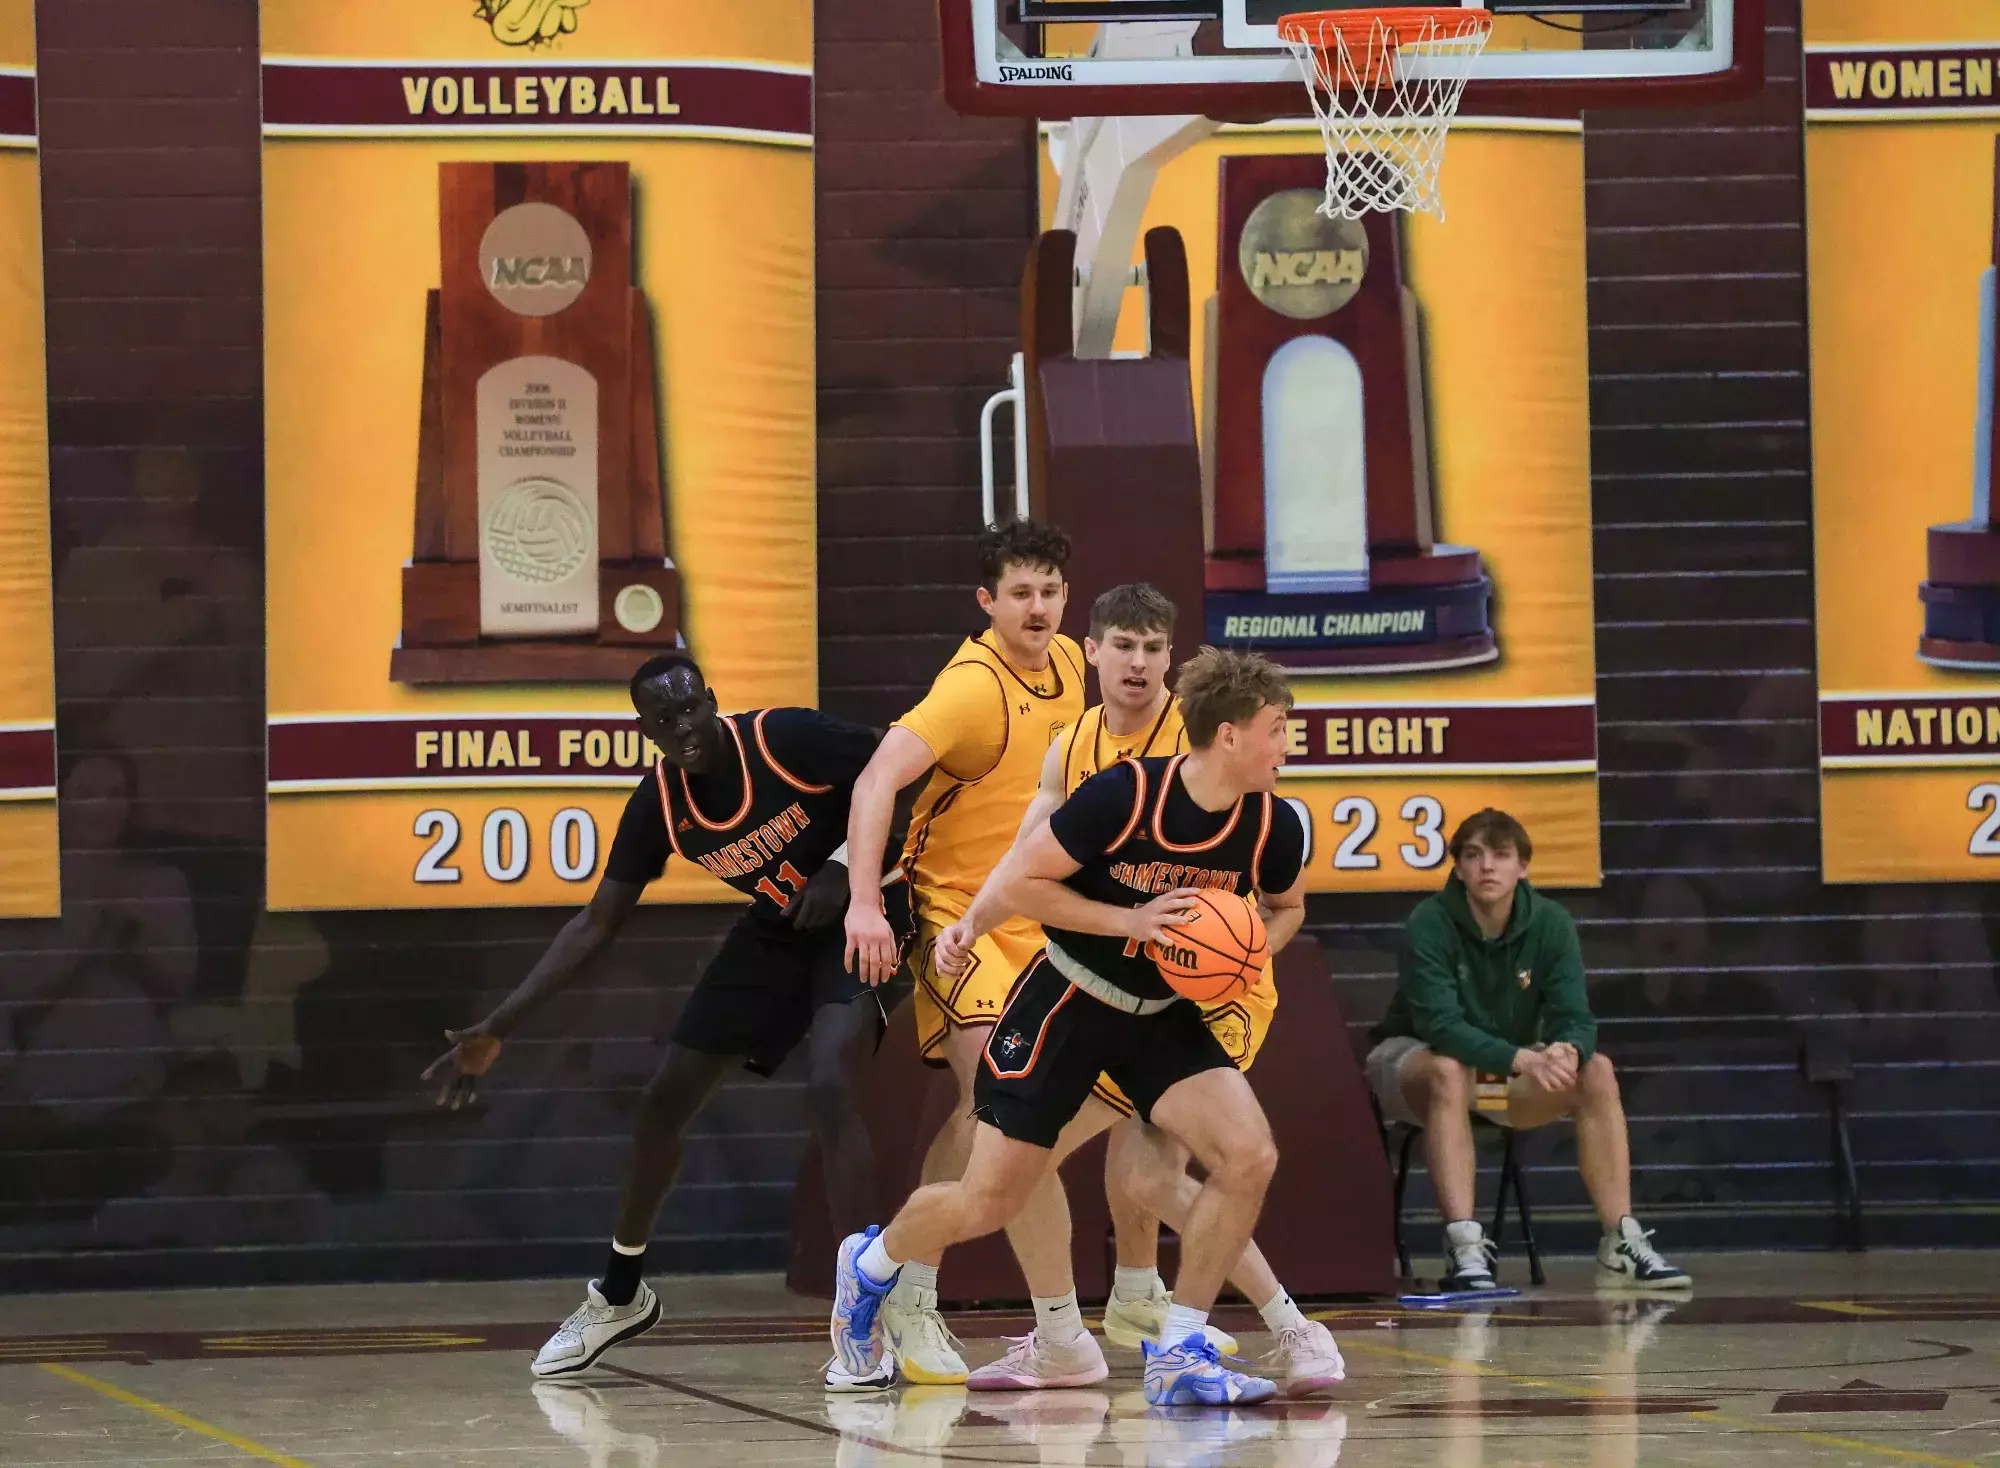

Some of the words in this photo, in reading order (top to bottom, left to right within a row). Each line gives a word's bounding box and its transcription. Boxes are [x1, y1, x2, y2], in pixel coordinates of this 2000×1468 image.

[999, 64, 1073, 82] SPALDING
[1829, 58, 2000, 100] WOMEN
[401, 76, 681, 115] VOLLEYBALL
[491, 256, 588, 288] NCAA
[1253, 250, 1364, 287] NCAA
[498, 445, 577, 457] CHAMPIONSHIP
[502, 429, 573, 441] VOLLEYBALL
[500, 602, 580, 614] SEMIFINALIST
[1224, 615, 1318, 638] REGIONAL
[1322, 610, 1426, 636] CHAMPION
[416, 730, 541, 768] FINAL
[1326, 717, 1450, 755] EIGHT
[413, 806, 599, 884] 200
[1283, 794, 1447, 870] 23
[755, 860, 808, 909] 11
[1109, 861, 1243, 894] JAMESTOWN
